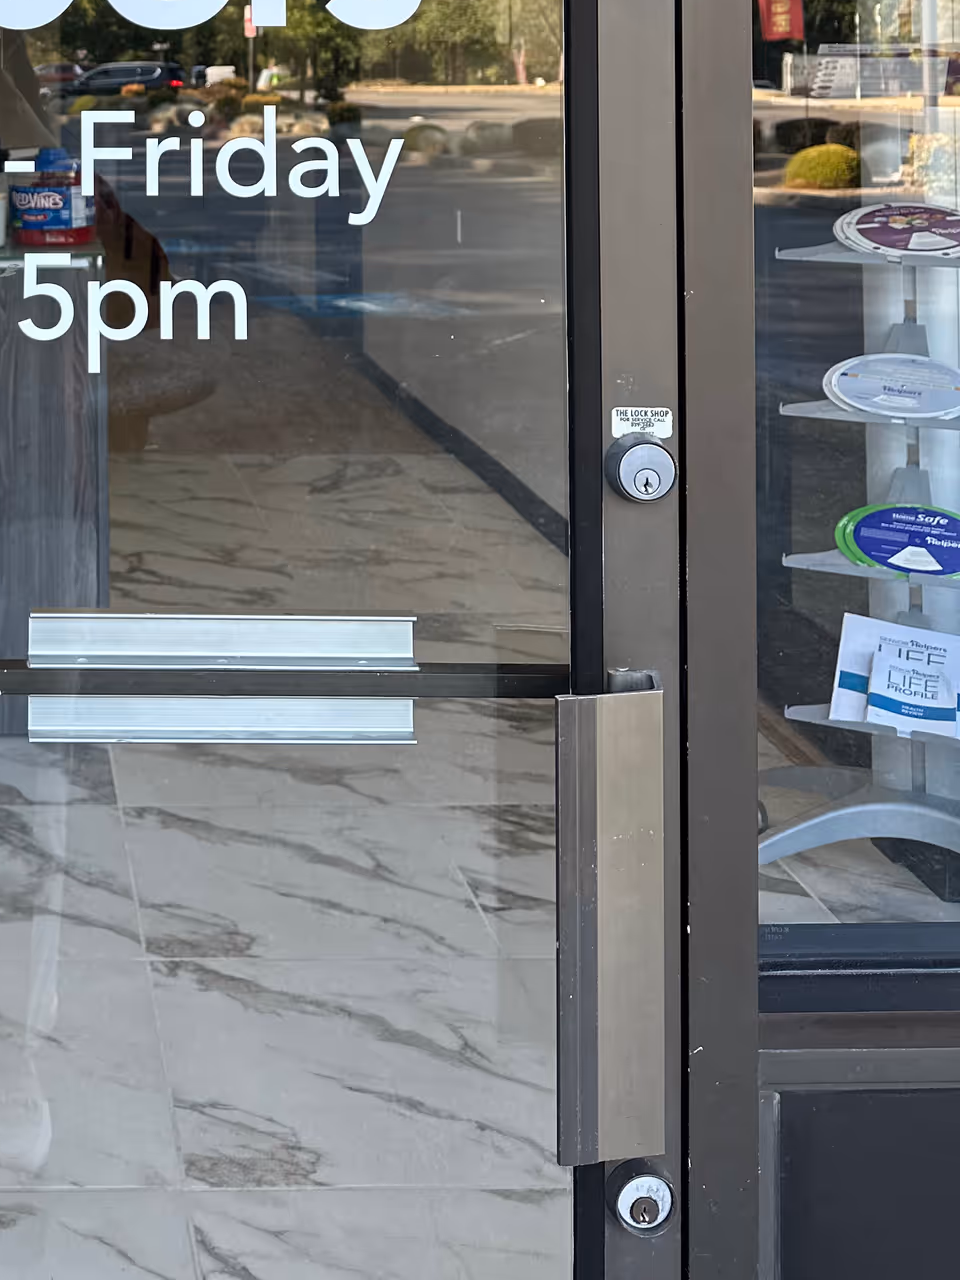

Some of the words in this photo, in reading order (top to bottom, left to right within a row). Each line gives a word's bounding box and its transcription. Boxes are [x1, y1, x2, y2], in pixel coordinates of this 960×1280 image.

[81, 104, 406, 226] Friday
[18, 253, 248, 375] 5pm
[615, 409, 628, 417] THE
[630, 409, 648, 417] LOCK
[650, 410, 669, 418] SHOP
[915, 513, 949, 525] Safe
[887, 669, 940, 693] LIFE
[886, 683, 939, 701] PROFILE
